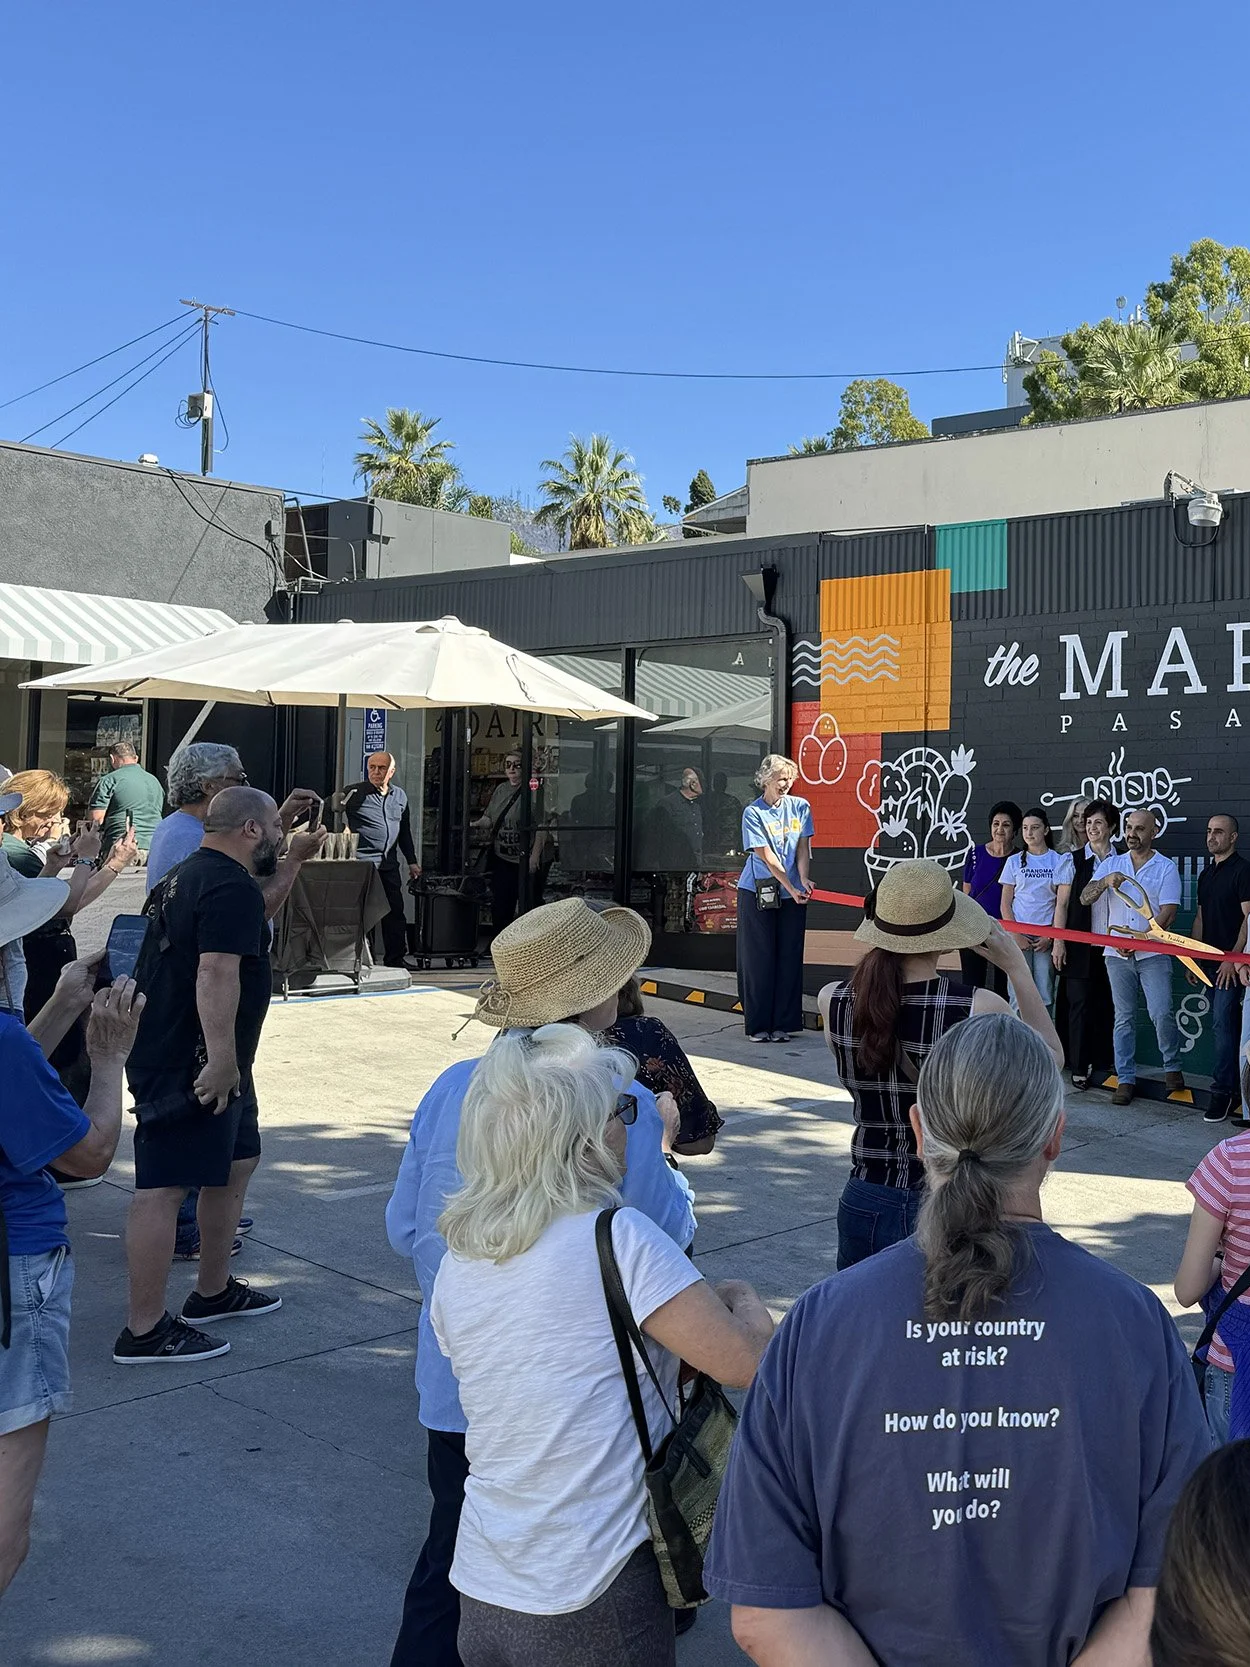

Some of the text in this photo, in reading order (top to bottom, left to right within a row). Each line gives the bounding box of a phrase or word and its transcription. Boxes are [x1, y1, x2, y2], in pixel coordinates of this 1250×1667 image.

[983, 642, 1040, 687] the
[906, 1319, 1045, 1343] Is your country
[942, 1346, 1008, 1367] at risk?
[884, 1407, 1060, 1433] How do you know?
[974, 1468, 1010, 1489] will
[932, 1499, 1001, 1530] you do?
